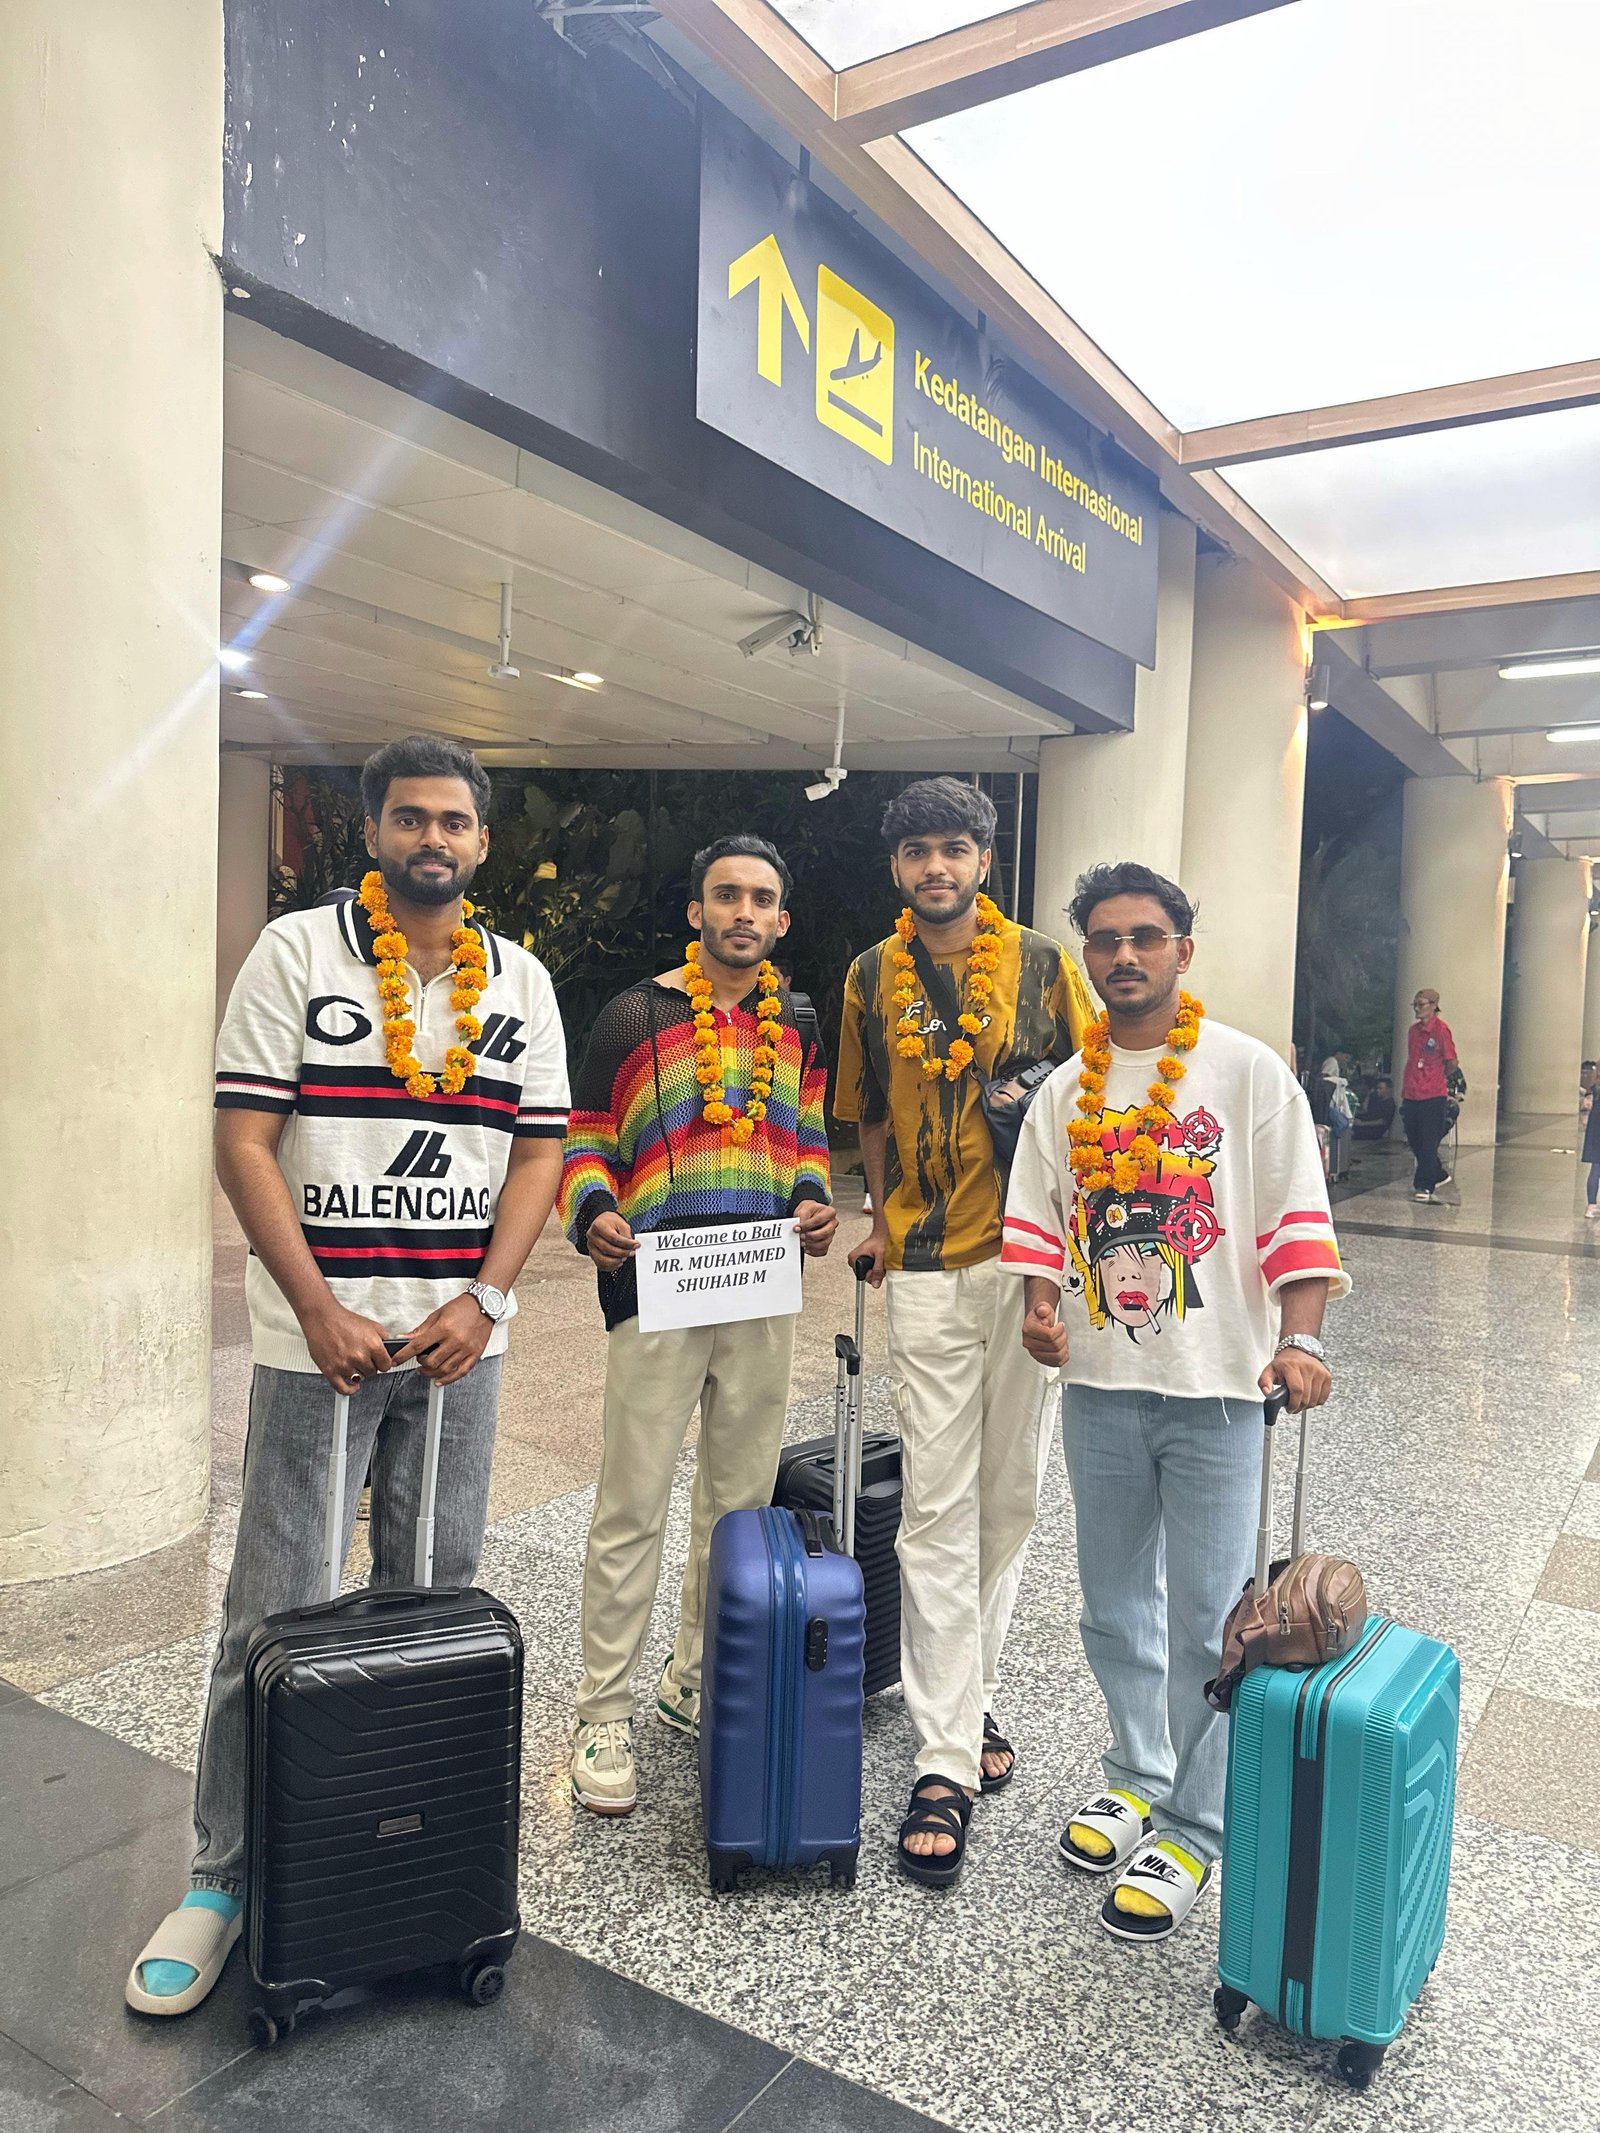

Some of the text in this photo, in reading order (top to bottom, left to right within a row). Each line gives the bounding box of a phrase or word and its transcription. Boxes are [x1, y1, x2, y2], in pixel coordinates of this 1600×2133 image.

[914, 350, 1143, 546] Kedatangan Internasional
[913, 431, 1086, 575] International Arrival
[656, 1223, 782, 1249] Welcome to Bali
[653, 1246, 786, 1274] MR. MUHAMMED
[676, 1269, 767, 1293] SHUHAIB M
[1090, 1797, 1128, 1819] NIKE
[1138, 1854, 1181, 1879] NIKE
